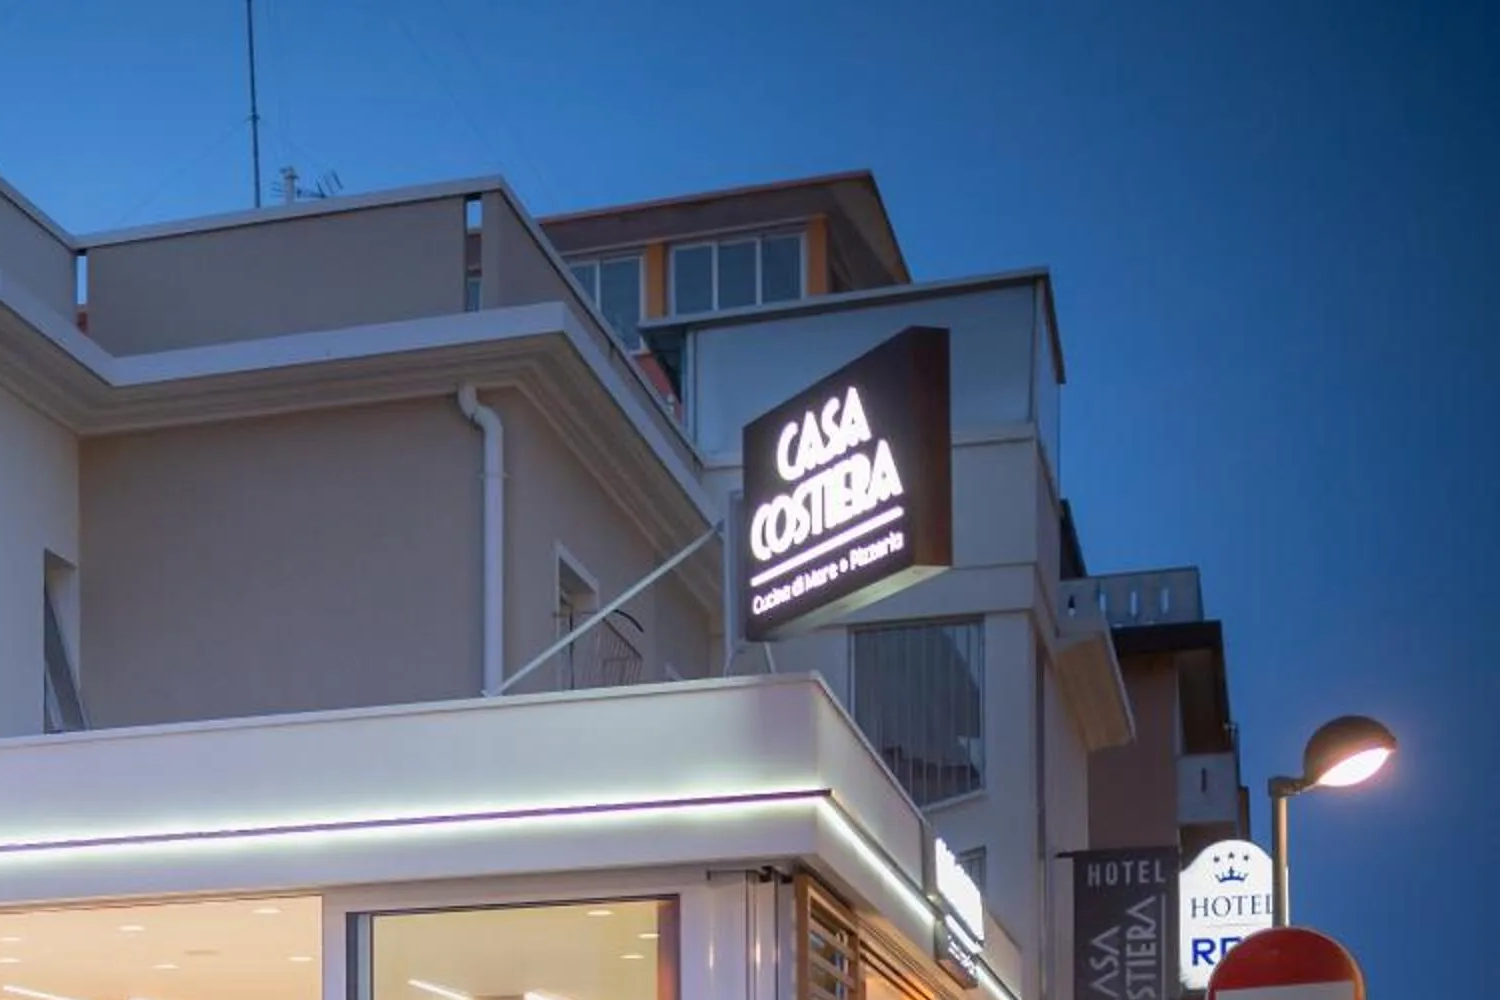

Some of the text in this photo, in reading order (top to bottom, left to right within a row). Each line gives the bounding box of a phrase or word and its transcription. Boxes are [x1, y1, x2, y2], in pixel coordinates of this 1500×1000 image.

[777, 386, 872, 481] CASA
[751, 439, 904, 561] COSTIERA
[1087, 860, 1166, 887] HOTEL
[1191, 894, 1273, 918] HOTEL
